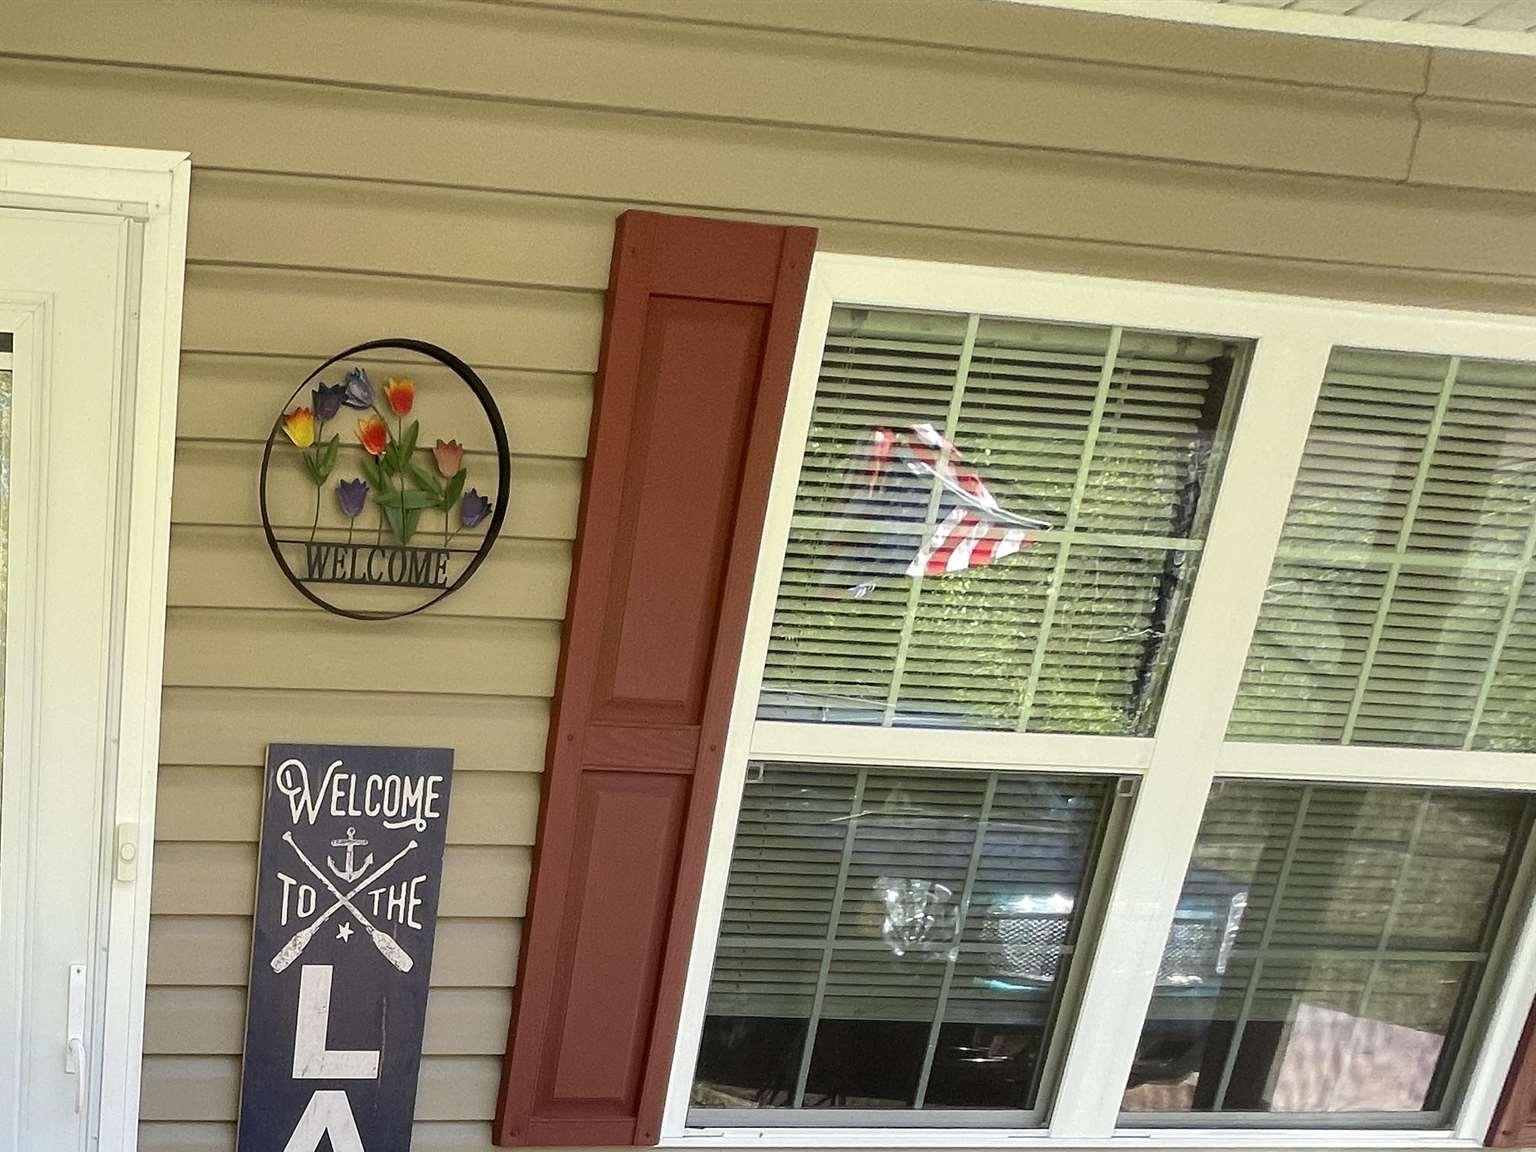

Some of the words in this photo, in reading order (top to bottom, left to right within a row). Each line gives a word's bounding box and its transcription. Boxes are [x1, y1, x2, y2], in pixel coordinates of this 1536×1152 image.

[306, 543, 449, 588] WELCOME
[276, 758, 443, 832] WELCOME
[277, 872, 317, 926] TO
[368, 875, 427, 930] THE
